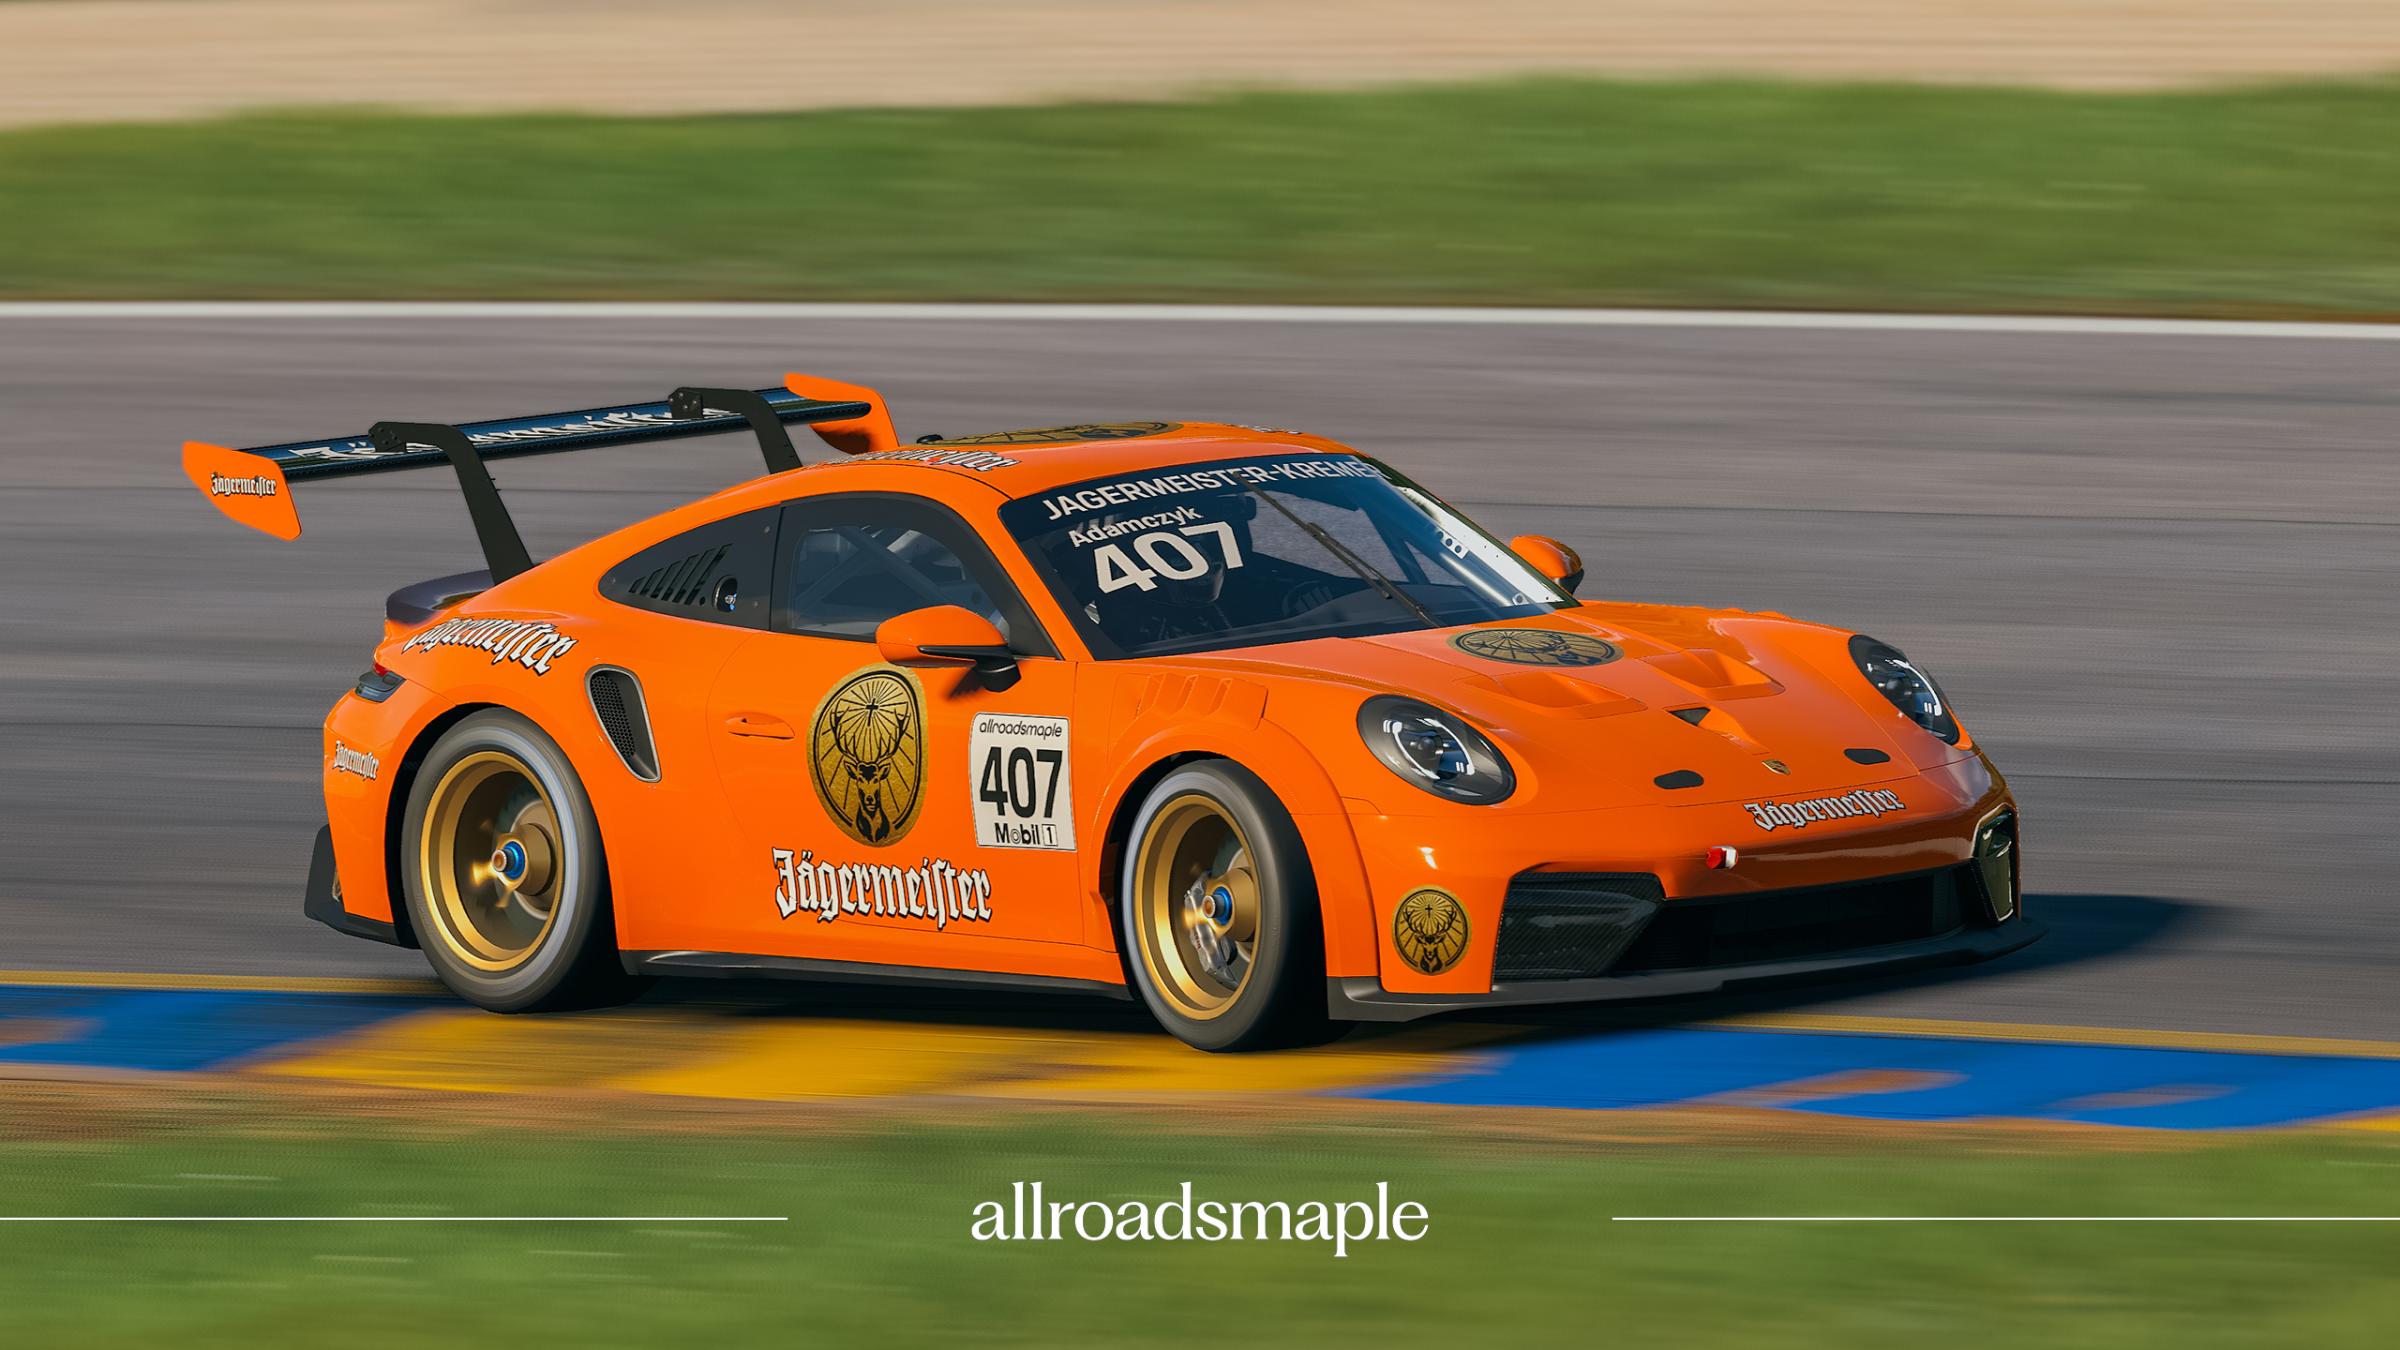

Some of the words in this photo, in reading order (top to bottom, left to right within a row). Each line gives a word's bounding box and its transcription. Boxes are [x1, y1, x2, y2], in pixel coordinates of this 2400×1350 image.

[1068, 506, 1204, 548] Adamczyk
[1094, 521, 1244, 594] 407
[979, 719, 1063, 741] allroadsmaple
[980, 746, 1063, 818] 407
[994, 823, 1041, 845] Mobil
[1044, 825, 1056, 845] 1
[772, 848, 992, 931] Jägermeister
